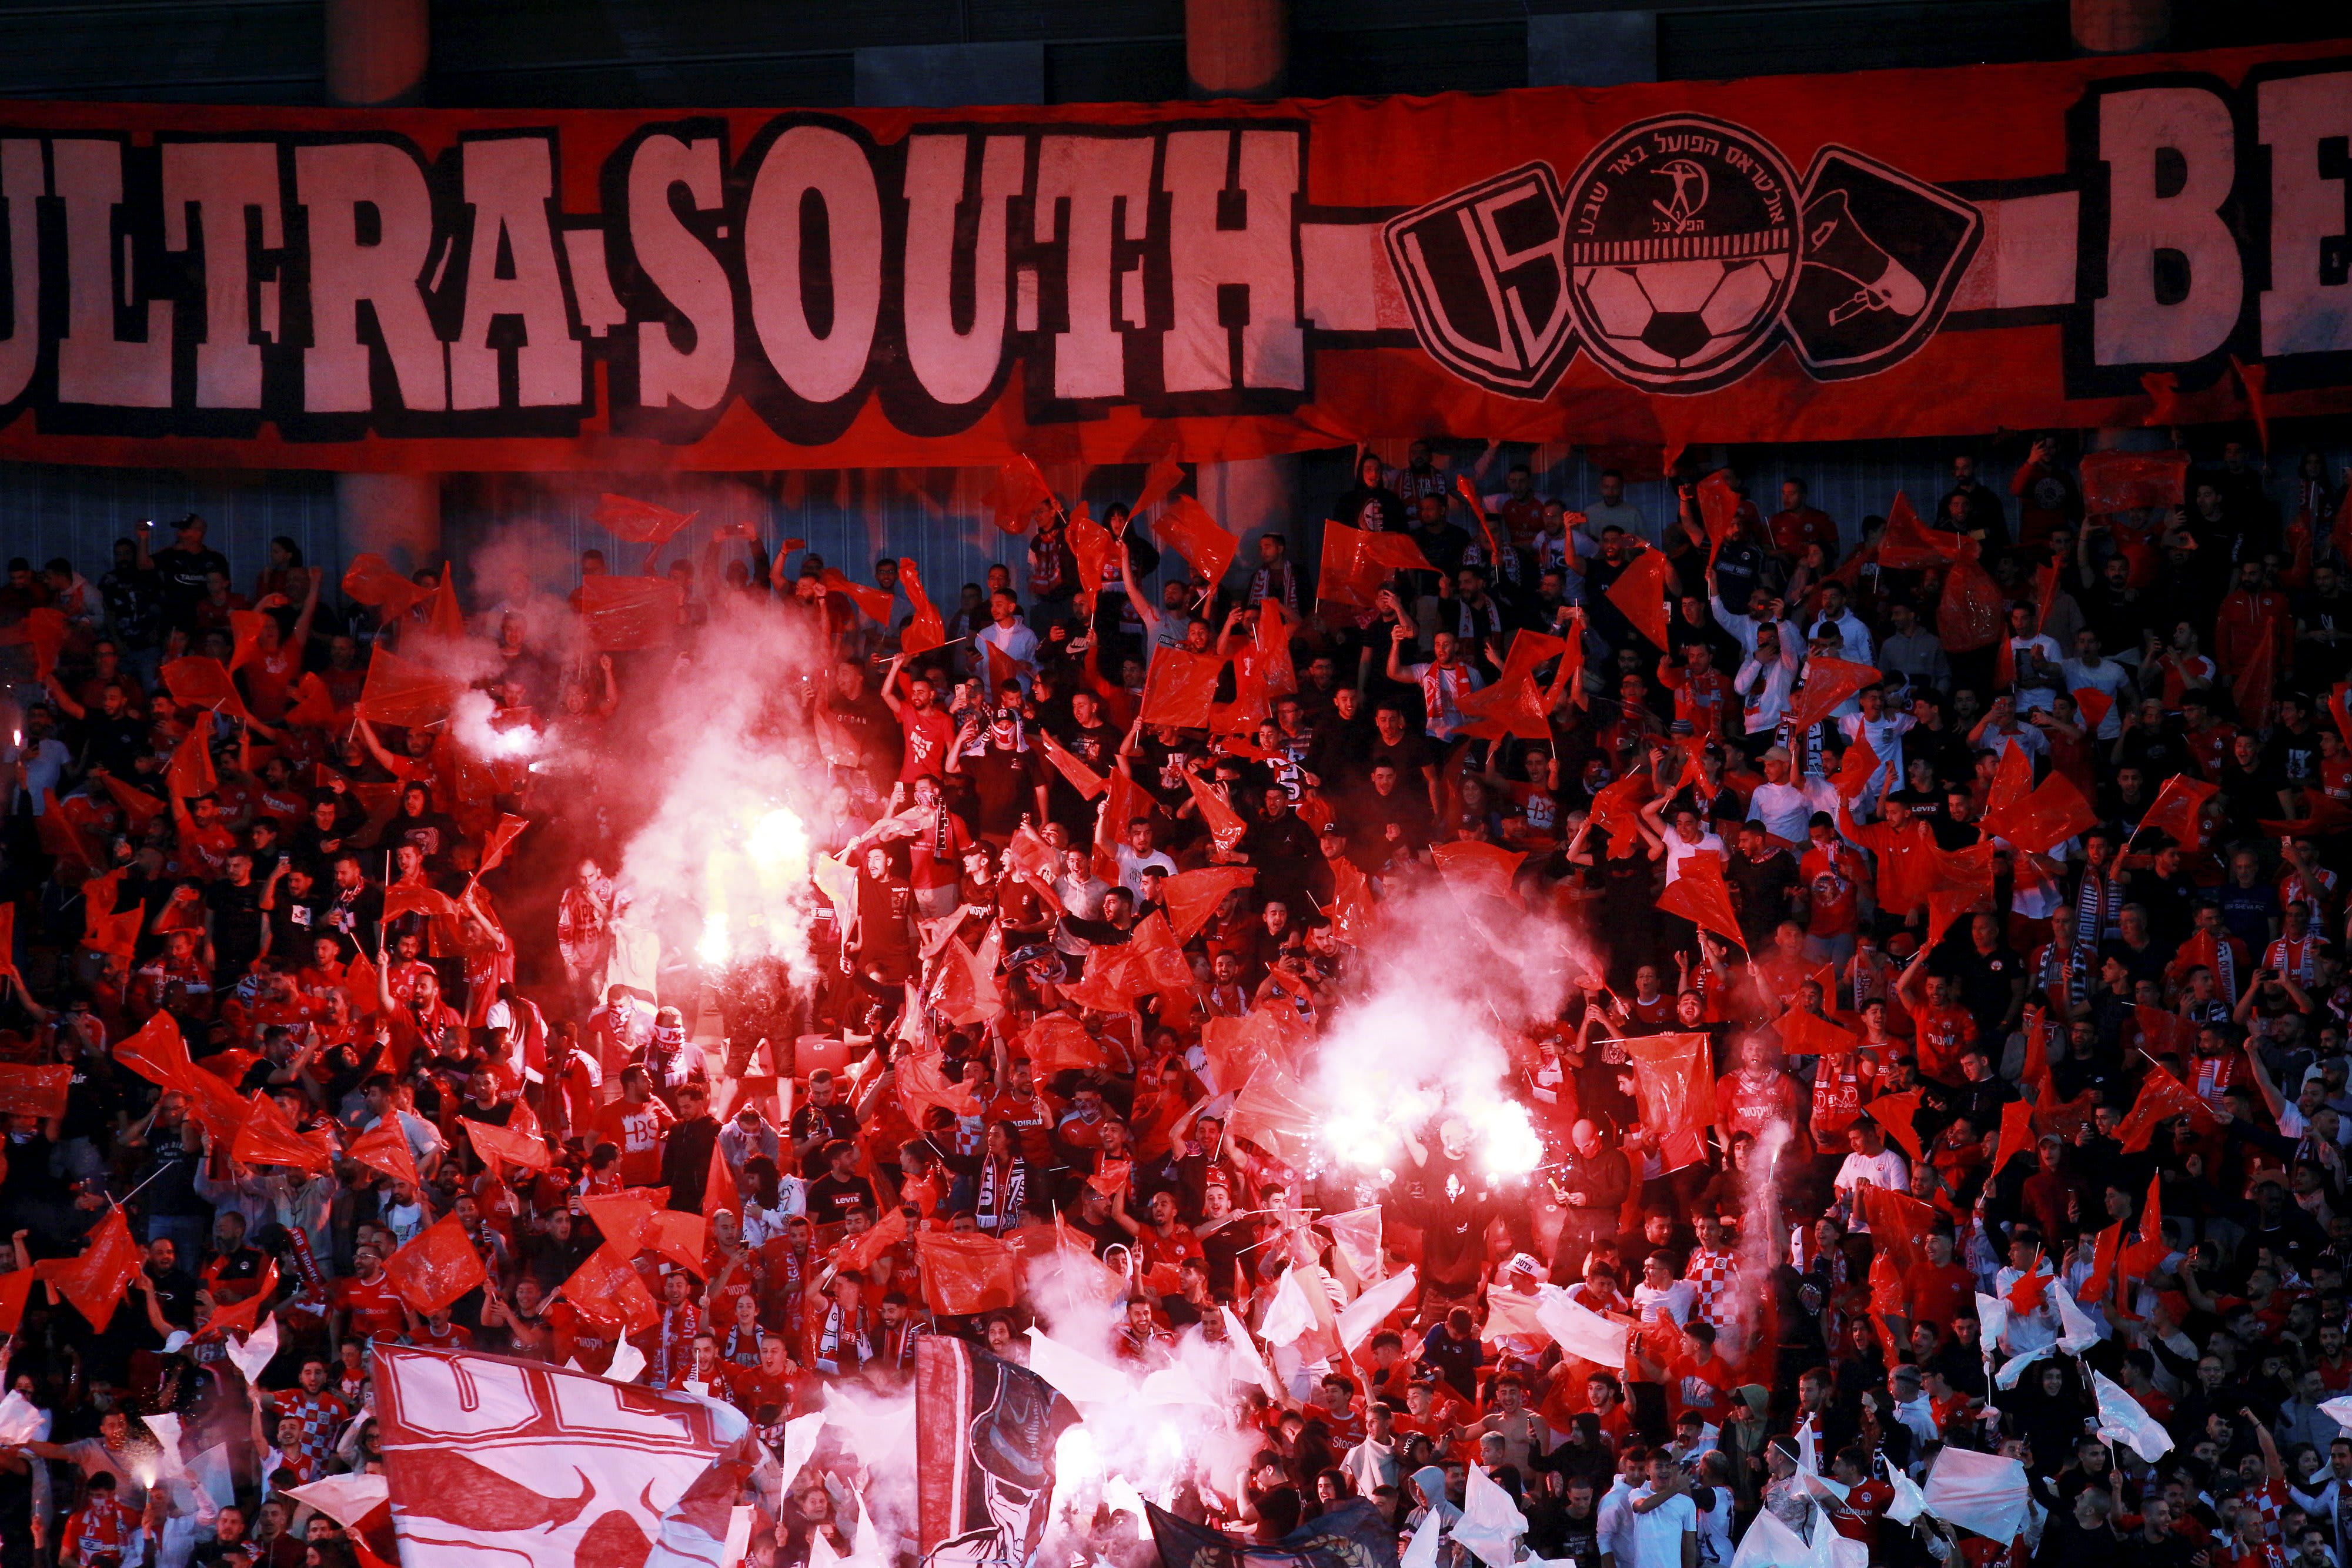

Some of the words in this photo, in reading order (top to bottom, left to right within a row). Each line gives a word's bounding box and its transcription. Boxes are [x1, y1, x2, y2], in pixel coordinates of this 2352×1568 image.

[1653, 133, 1720, 156] הפועל
[1607, 145, 1650, 175] באר
[1725, 146, 1786, 225] אולטראס
[1578, 181, 1609, 235] שבע
[627, 125, 1304, 410] SOUTH
[837, 714, 867, 725] ORDAN
[1012, 1118, 1043, 1127] ADIRAN
[1515, 1258, 1534, 1273] OUTH
